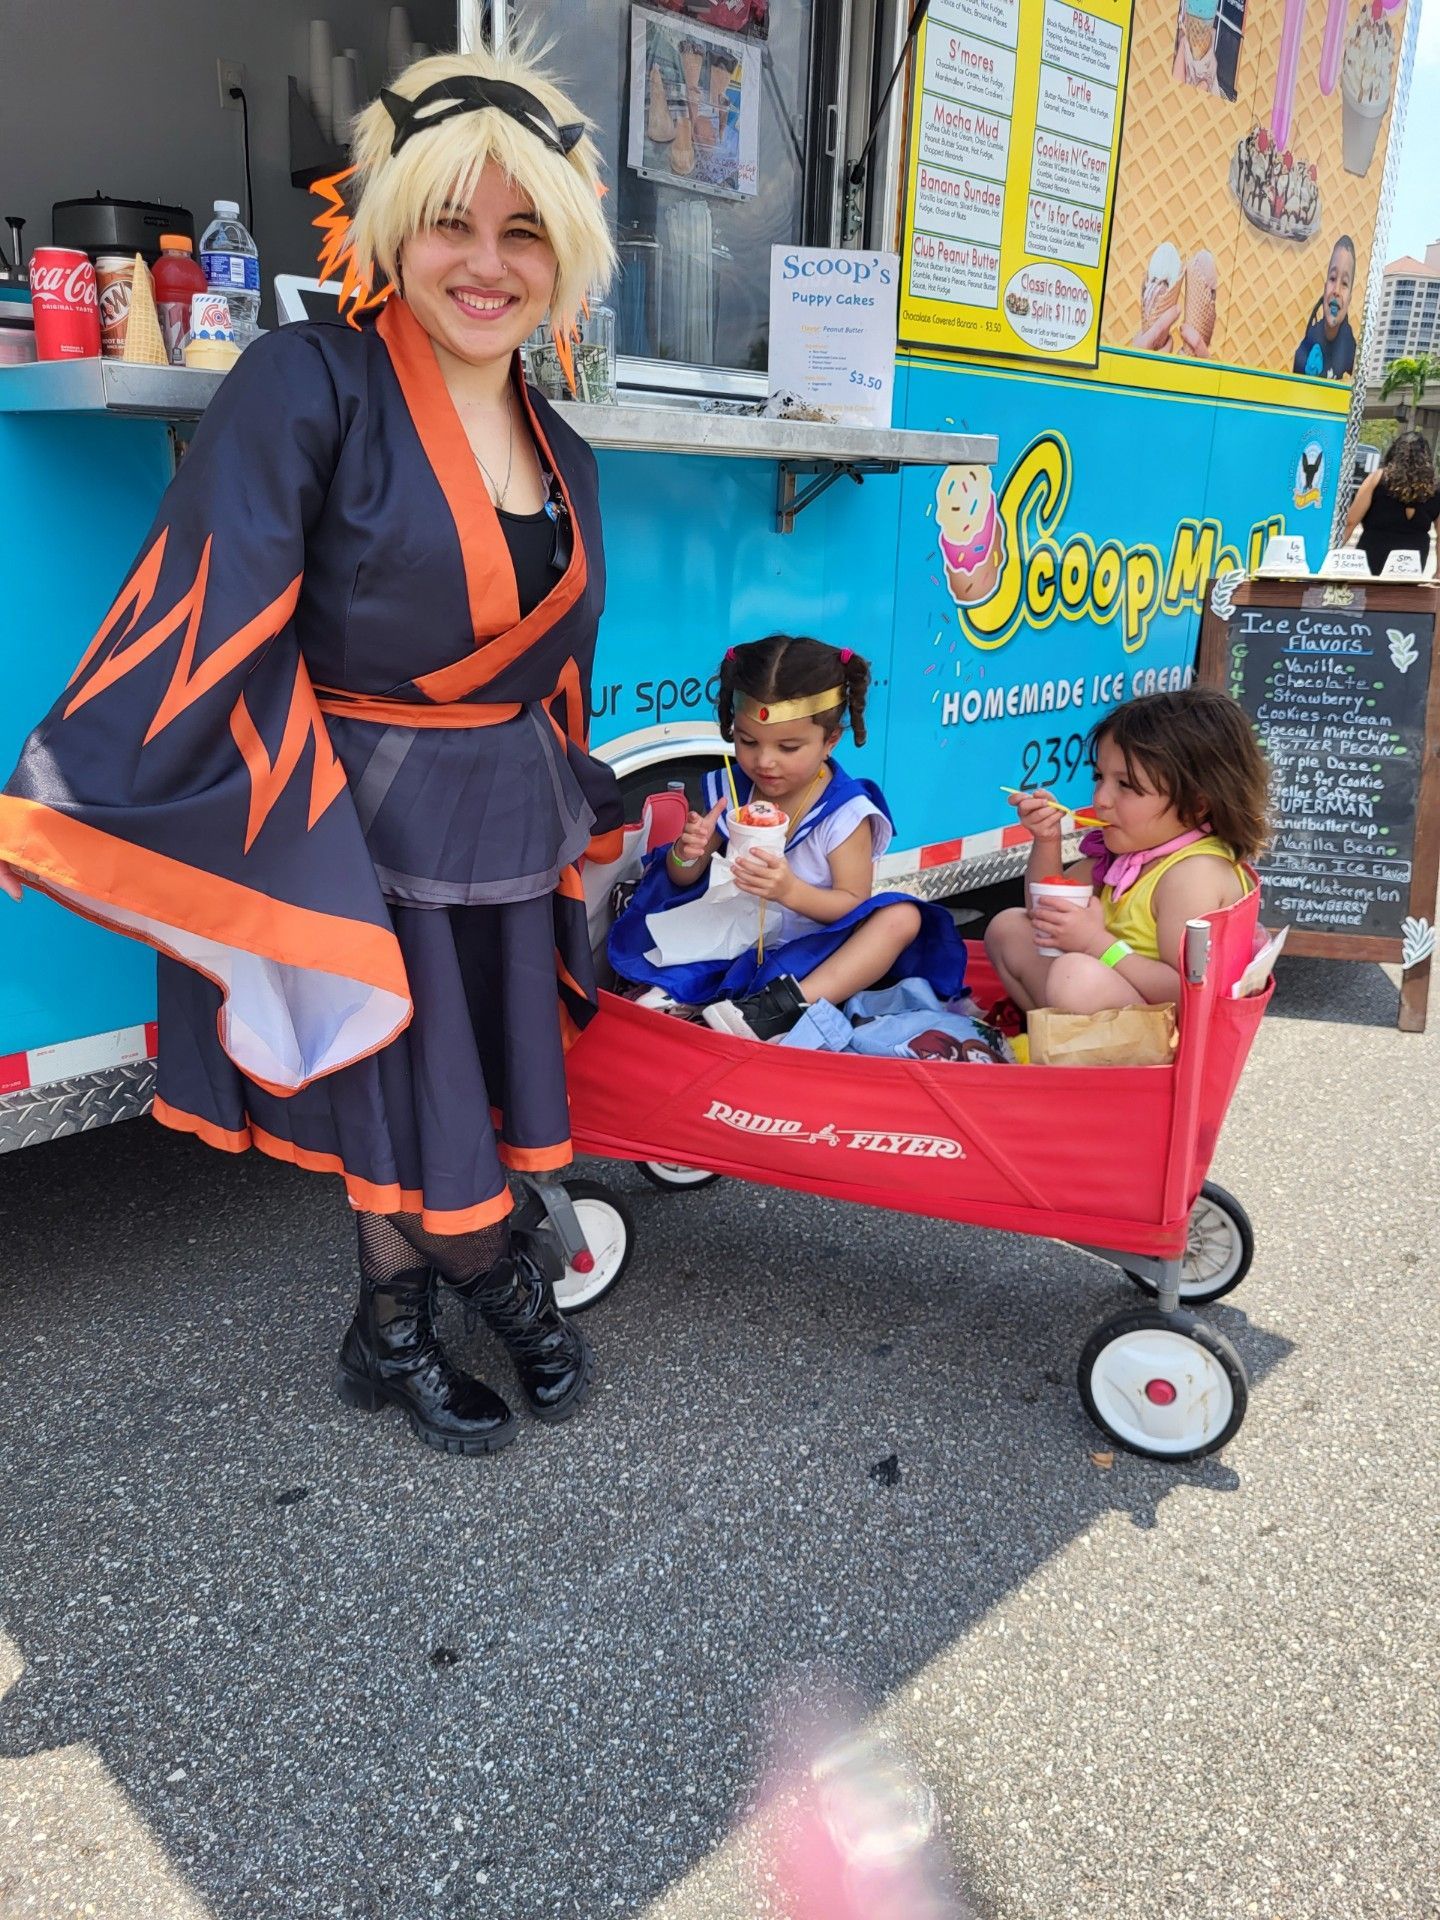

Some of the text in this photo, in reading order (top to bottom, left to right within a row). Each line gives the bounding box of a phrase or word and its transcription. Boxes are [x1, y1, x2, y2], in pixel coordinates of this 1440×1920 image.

[949, 38, 994, 72] S'mores
[1067, 76, 1091, 102] Turtle
[934, 102, 1000, 139] Mocha Mud
[1037, 137, 1068, 162] Cookies
[921, 169, 1000, 206] Banana Sundae
[1072, 210, 1101, 232] Cookie
[914, 236, 998, 269] Club Peanut Butter
[782, 255, 891, 285] Scoop's
[1022, 273, 1088, 301] Classic Banana
[792, 291, 874, 306] Puppy Cakes
[76, 306, 93, 314] TASTE
[903, 310, 931, 323] Chocolate
[932, 314, 955, 326] Covered
[957, 318, 977, 329] Banana
[1032, 300, 1086, 325] Split $11.00
[849, 370, 882, 391] $3.50
[960, 430, 1162, 652] Scoop
[1240, 612, 1372, 637] Ice Cream
[1289, 635, 1363, 652] Flavors
[1285, 657, 1347, 674] Vanilla
[1274, 674, 1369, 690] Chocolate
[941, 677, 1084, 726] HOMEMADE
[1092, 672, 1125, 705] ICE
[1274, 688, 1364, 713] Strawberry
[1260, 721, 1316, 738] Special
[1323, 726, 1355, 739] Mint
[1340, 741, 1394, 756] PECAN
[1273, 752, 1371, 772] Purple Daze
[1295, 772, 1309, 784] is
[1313, 770, 1334, 787] for
[1338, 774, 1384, 789] Cookie
[1316, 786, 1371, 804] Coffee
[1266, 797, 1373, 818] SUPERMAN
[1351, 822, 1378, 840] Cup
[1282, 834, 1338, 852] Vanilla
[1344, 839, 1386, 854] Bean
[1270, 855, 1326, 872] Italian
[1331, 859, 1368, 875] Ice
[1312, 877, 1400, 901] Watermelon
[1281, 897, 1369, 914] STRAWBERRY
[1296, 912, 1362, 925] LEMONADE
[703, 1100, 963, 1159] RADIO FLYER
